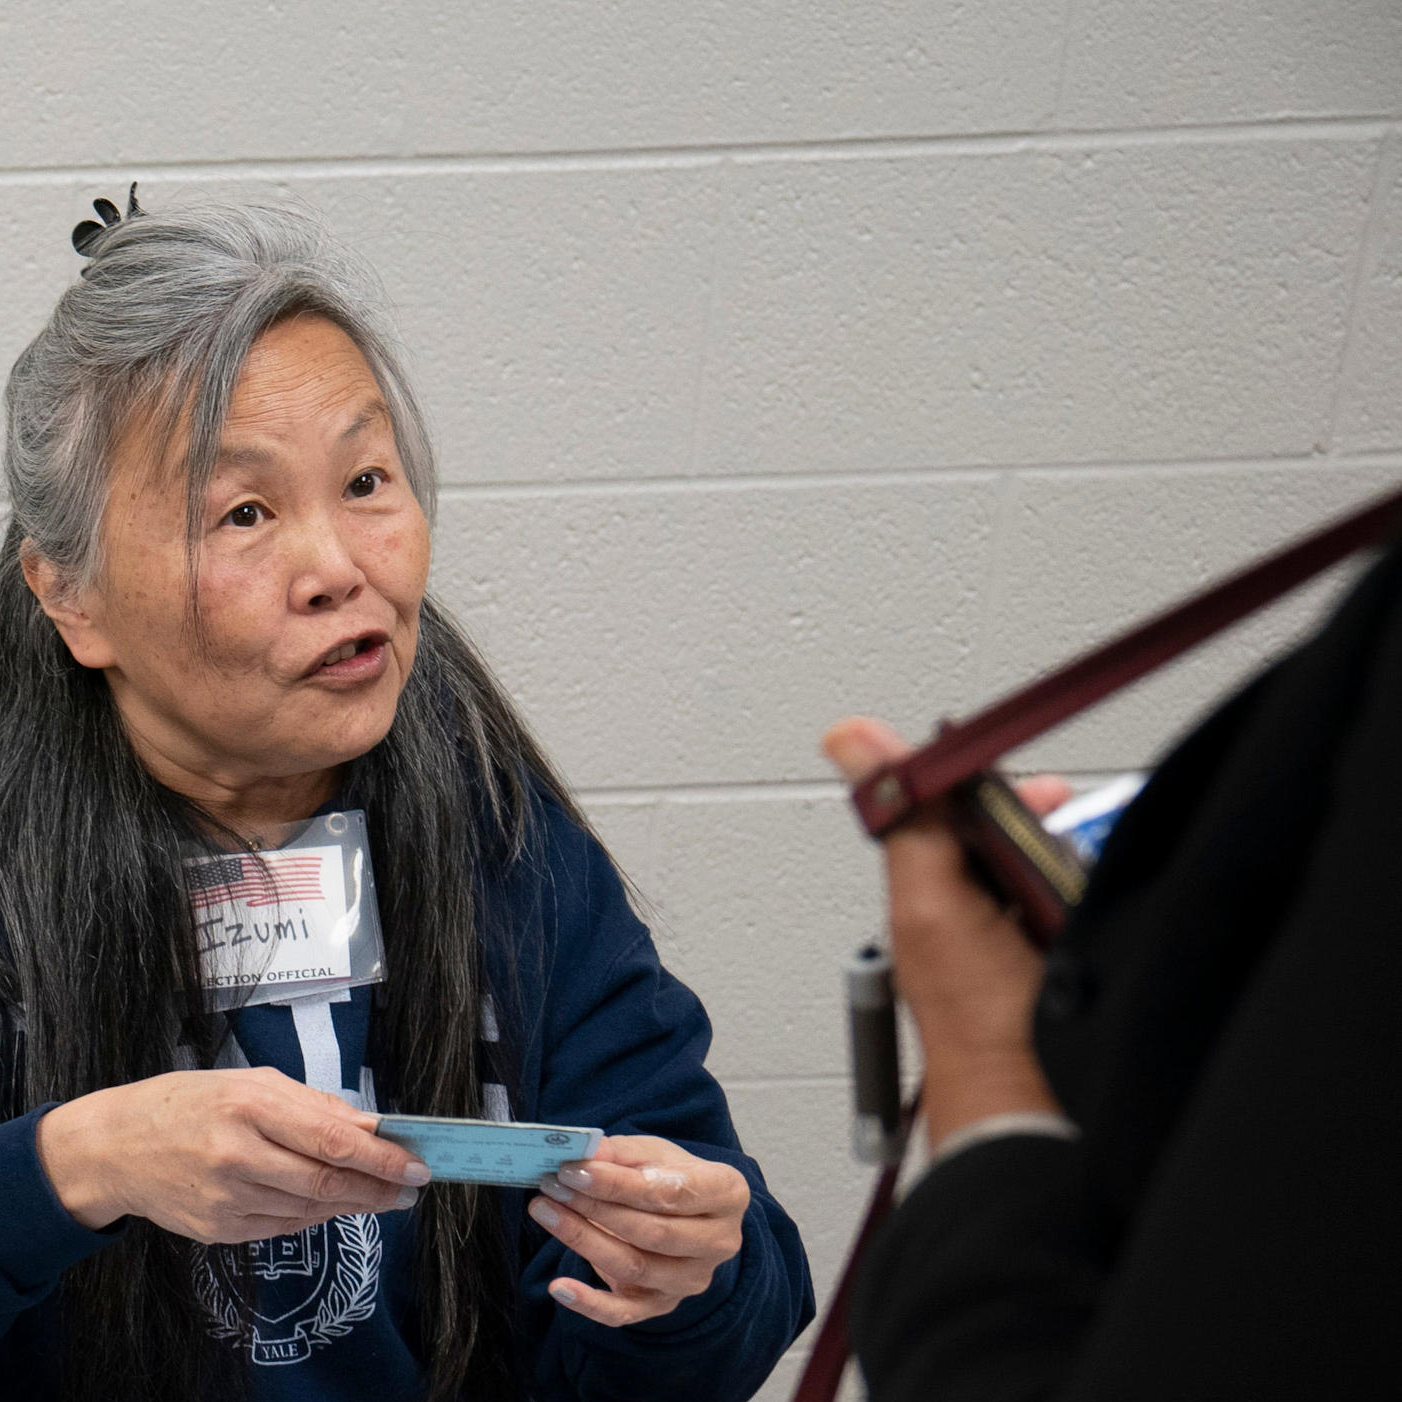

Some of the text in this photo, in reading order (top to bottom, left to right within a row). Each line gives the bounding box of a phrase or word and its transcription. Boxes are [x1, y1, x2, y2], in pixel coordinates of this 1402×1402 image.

[195, 908, 311, 953] Izumi
[204, 967, 336, 987] ECTION OFFICIAL
[261, 1342, 299, 1360] YALE
